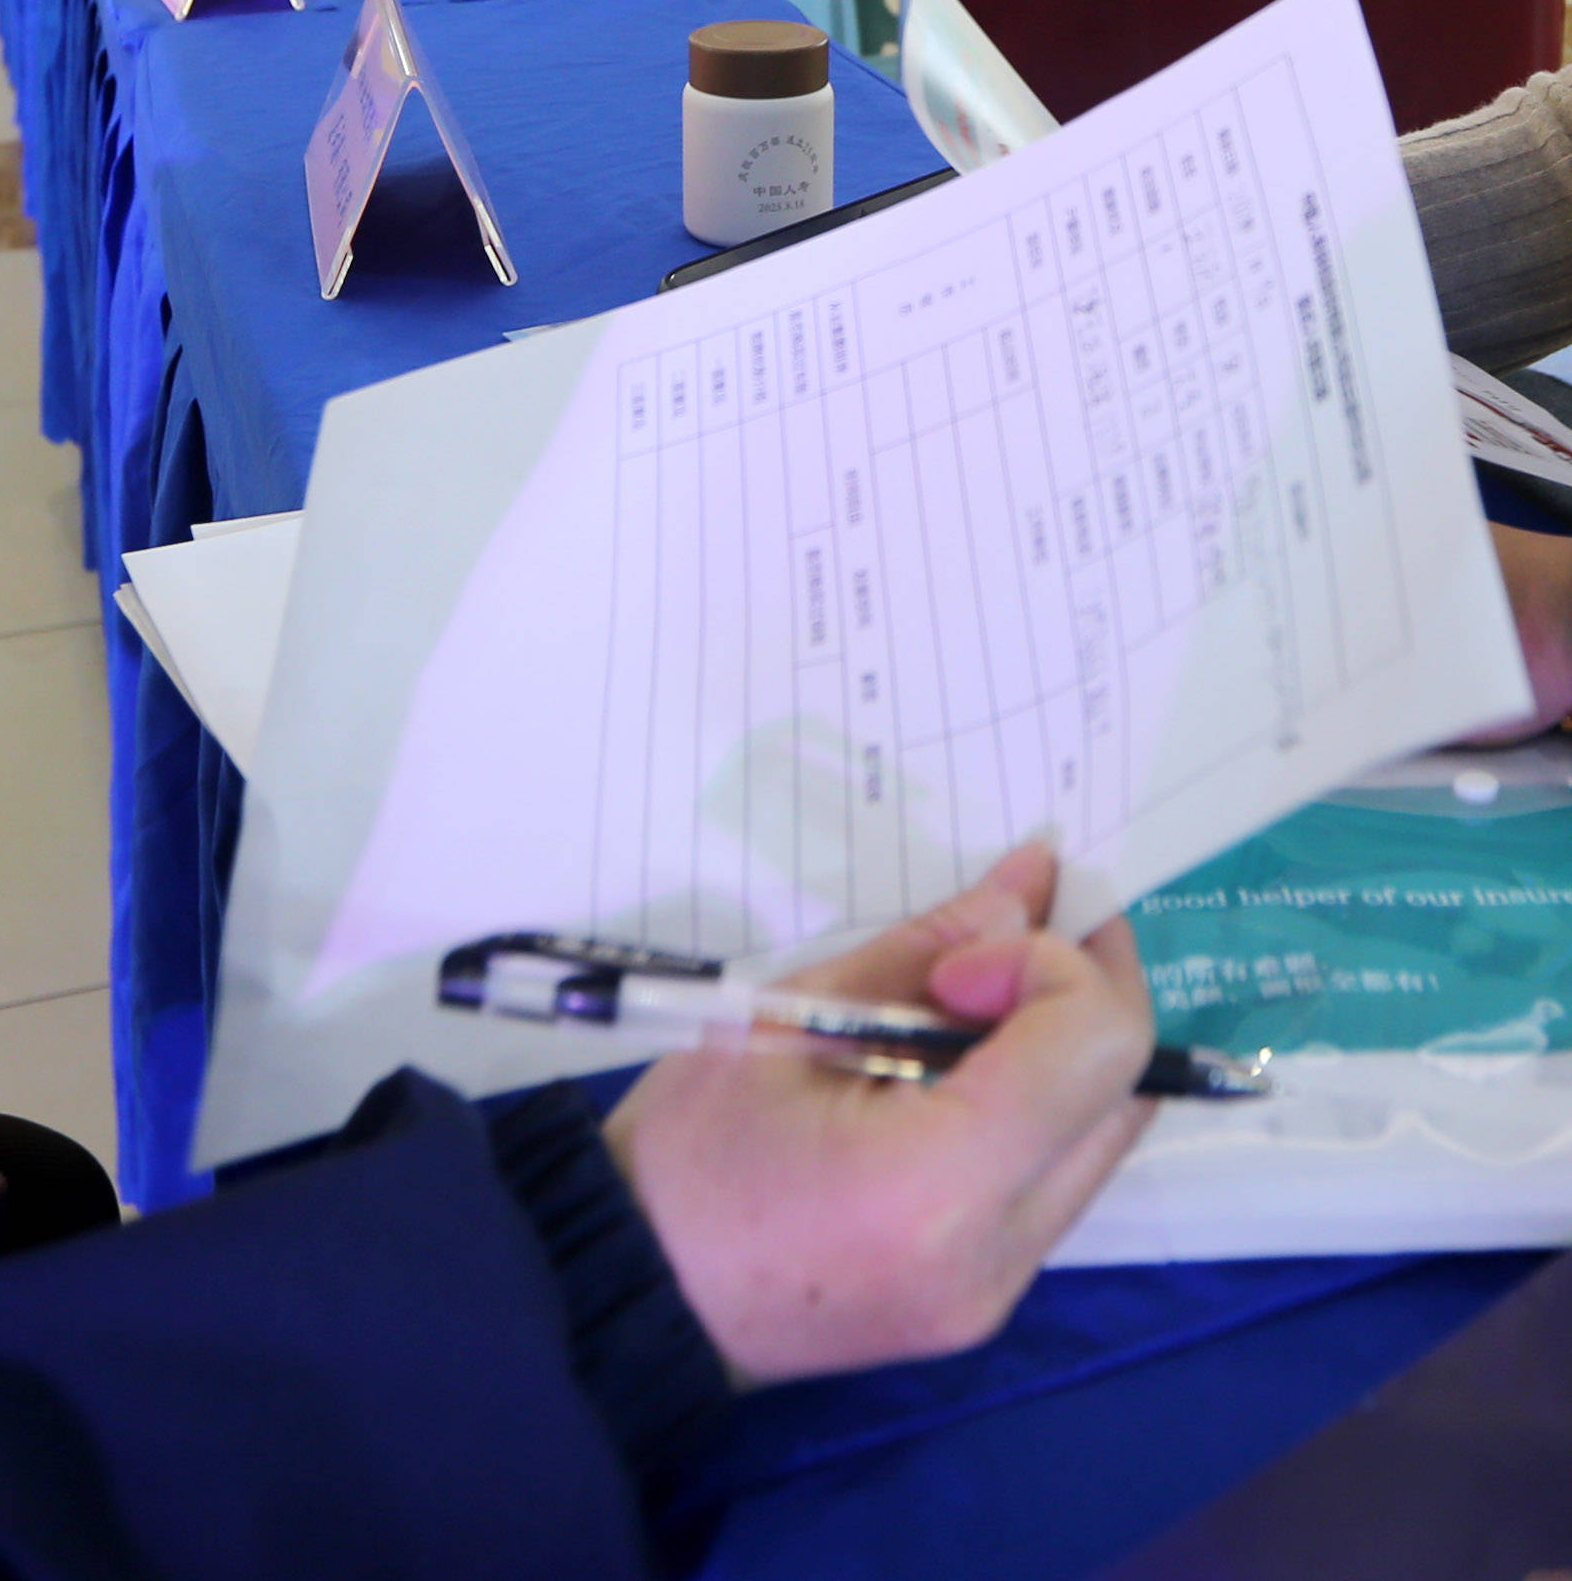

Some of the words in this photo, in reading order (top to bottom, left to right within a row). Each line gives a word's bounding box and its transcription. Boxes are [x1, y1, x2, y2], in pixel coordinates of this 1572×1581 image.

[1141, 889, 1227, 915] good
[1238, 885, 1352, 910] helper
[1361, 885, 1397, 907] of
[1406, 889, 1463, 908] our
